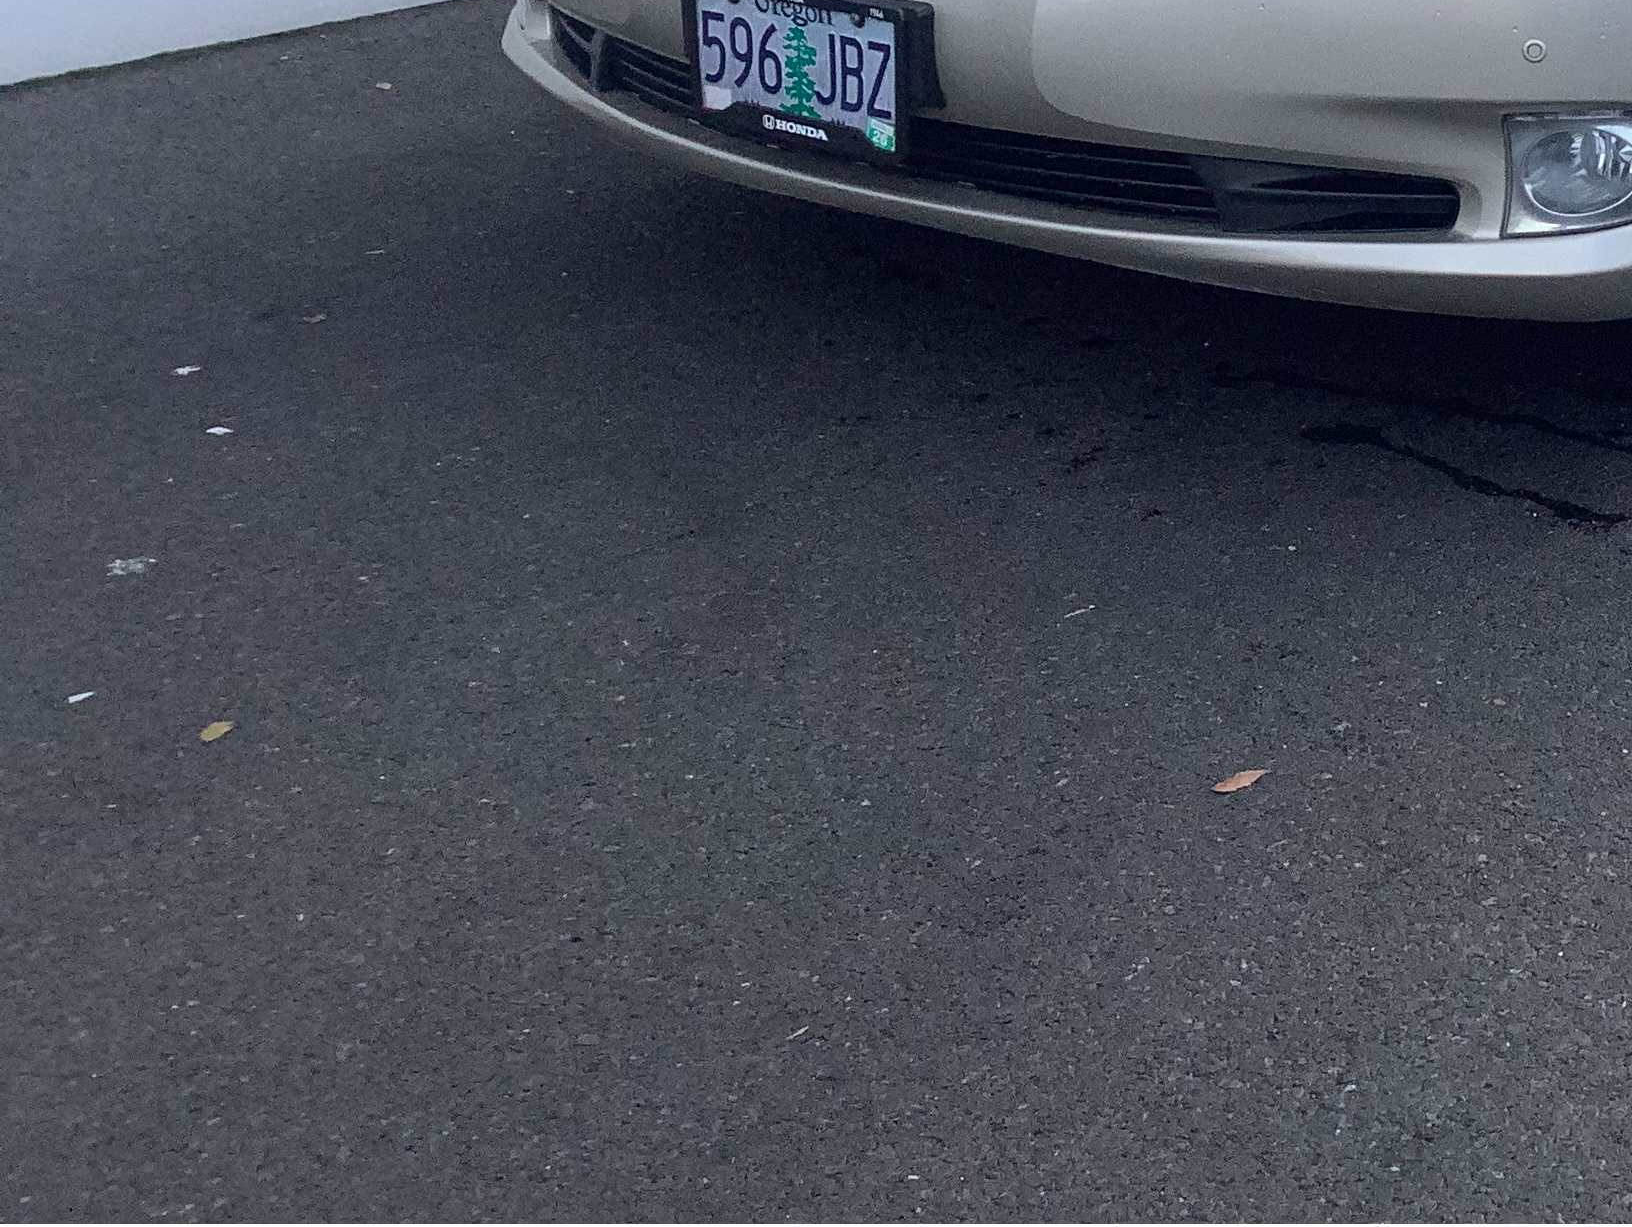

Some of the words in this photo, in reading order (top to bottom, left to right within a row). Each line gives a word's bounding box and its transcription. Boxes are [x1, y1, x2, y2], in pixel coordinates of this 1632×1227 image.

[701, 10, 783, 95] 596
[815, 33, 892, 120] JBZ
[775, 119, 829, 141] HONDA
